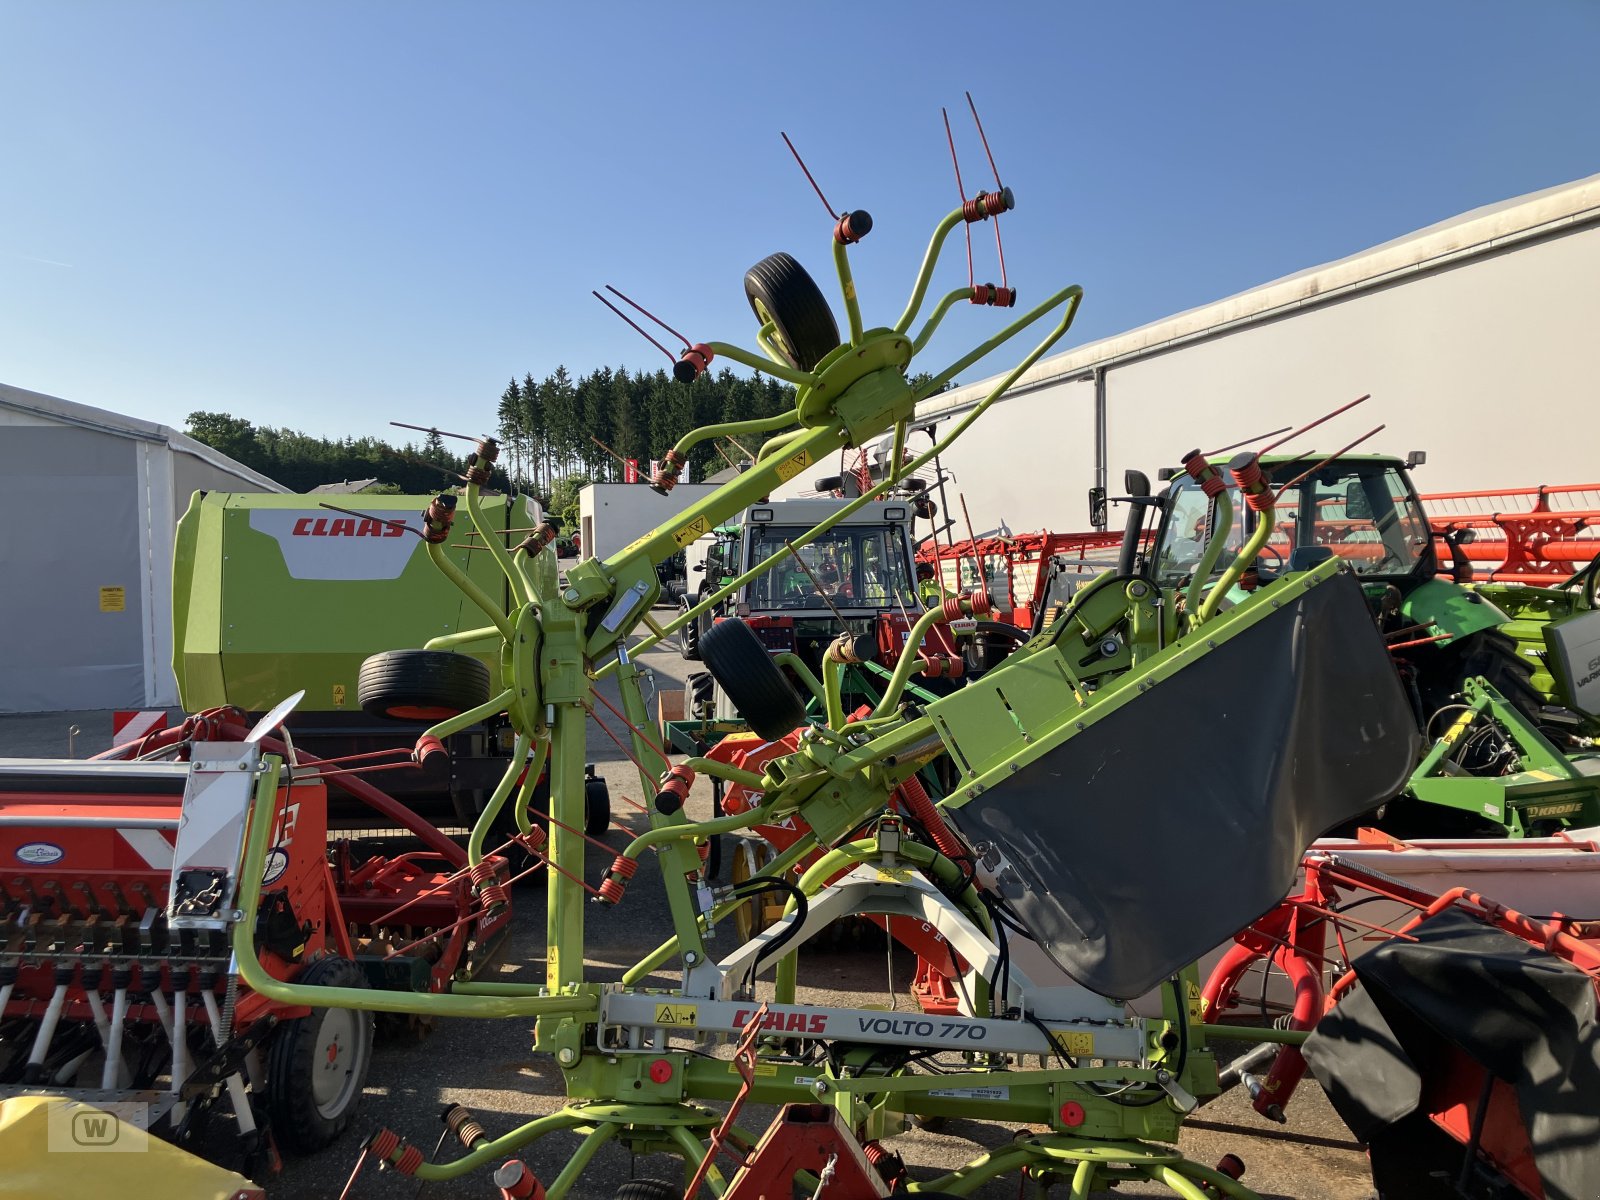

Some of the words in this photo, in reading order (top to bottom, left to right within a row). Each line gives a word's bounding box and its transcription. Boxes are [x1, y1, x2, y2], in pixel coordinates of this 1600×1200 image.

[292, 518, 407, 537] CLAAS
[1538, 803, 1584, 817] KRONE
[858, 1017, 934, 1037] VOLTO
[939, 1023, 987, 1040] 770
